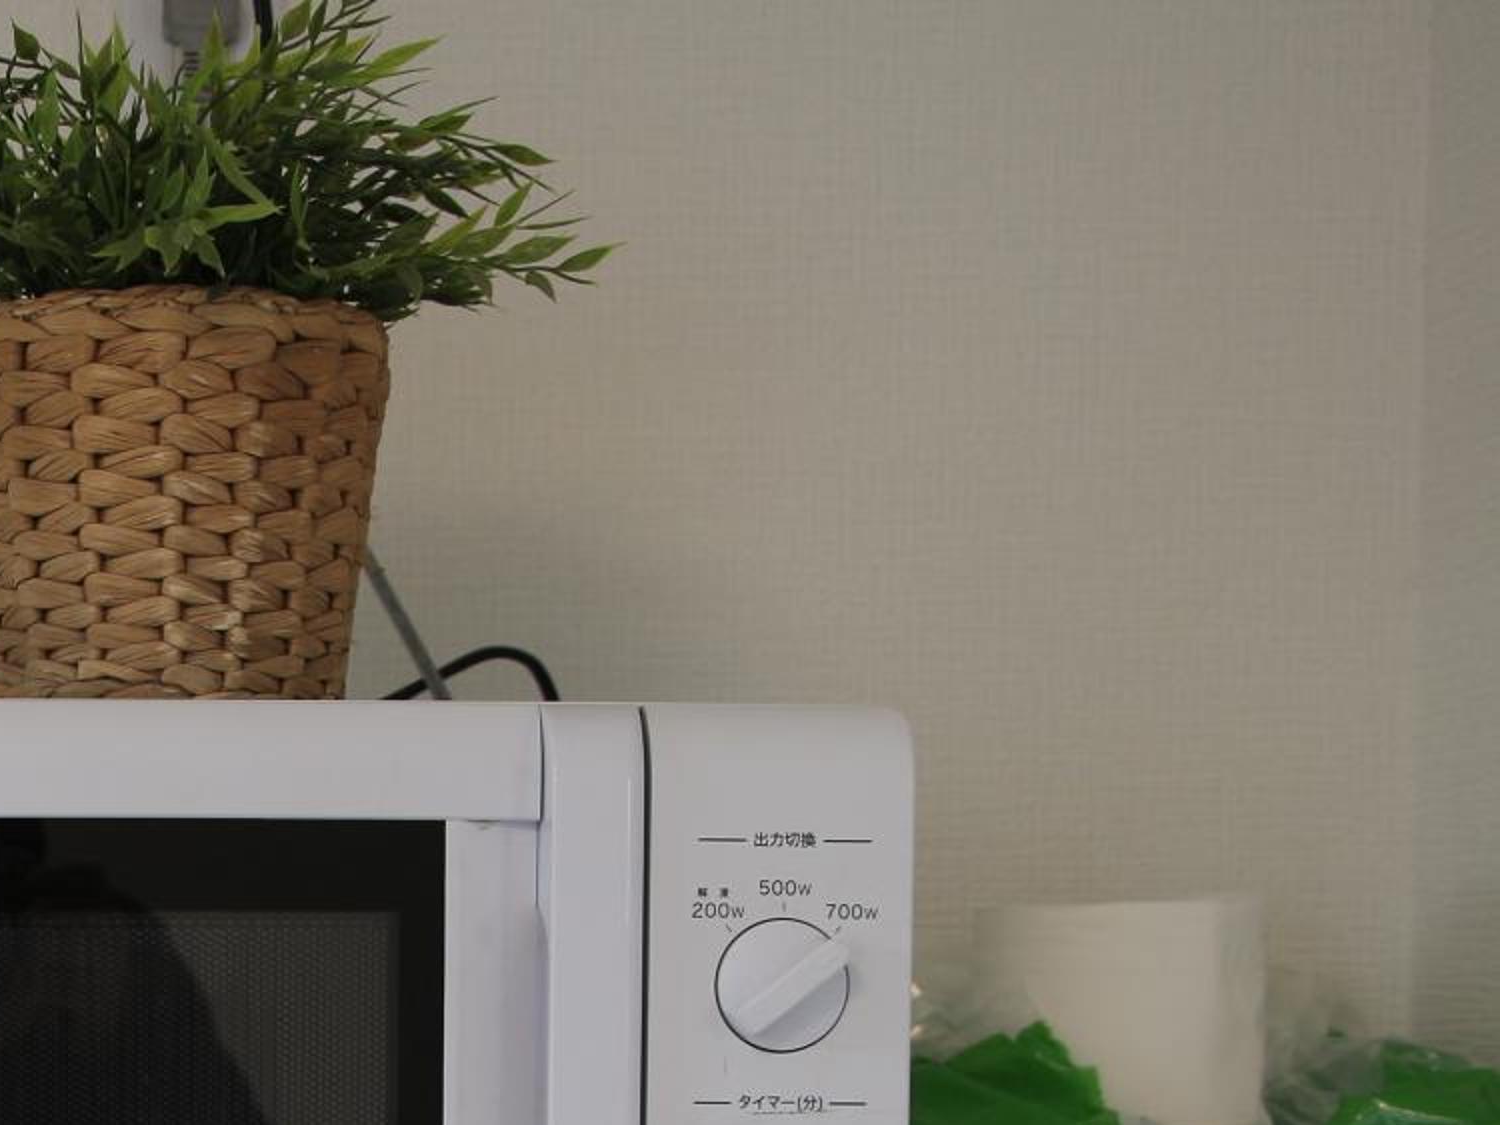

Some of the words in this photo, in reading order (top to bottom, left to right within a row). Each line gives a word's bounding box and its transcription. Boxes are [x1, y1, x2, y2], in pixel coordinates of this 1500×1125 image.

[753, 831, 817, 848] 出力切換
[739, 1095, 823, 1111] タイマー(分)
